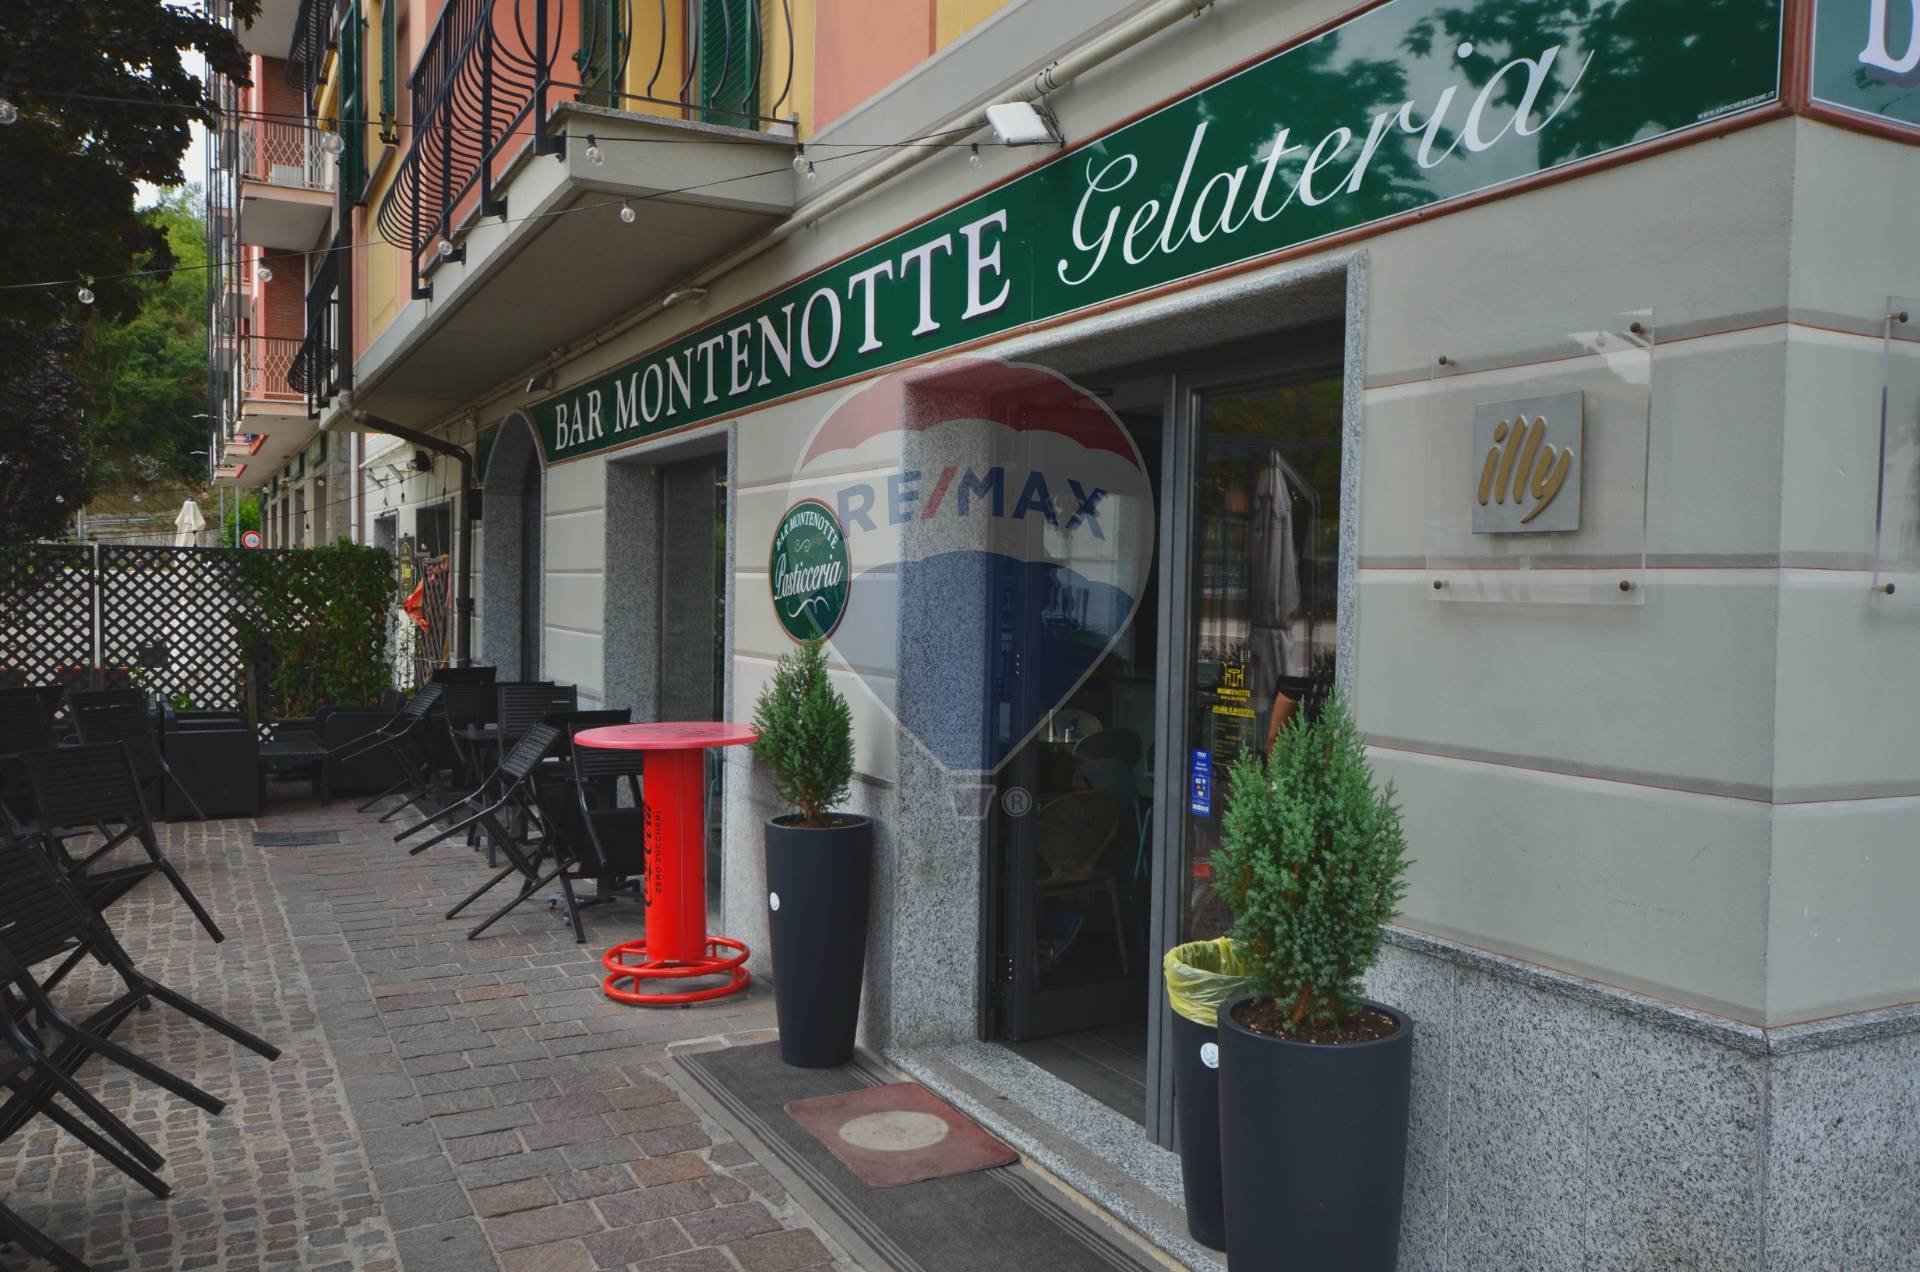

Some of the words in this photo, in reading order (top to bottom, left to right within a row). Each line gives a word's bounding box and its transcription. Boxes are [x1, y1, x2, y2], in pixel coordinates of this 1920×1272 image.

[1057, 42, 1595, 285] Gelateria
[554, 388, 604, 451] BAR
[614, 208, 1011, 433] MONTENOTTE
[1477, 414, 1573, 524] illy
[774, 552, 843, 601] Pasticceria
[776, 524, 788, 551] BAR
[789, 511, 839, 550] MONTENOTTE
